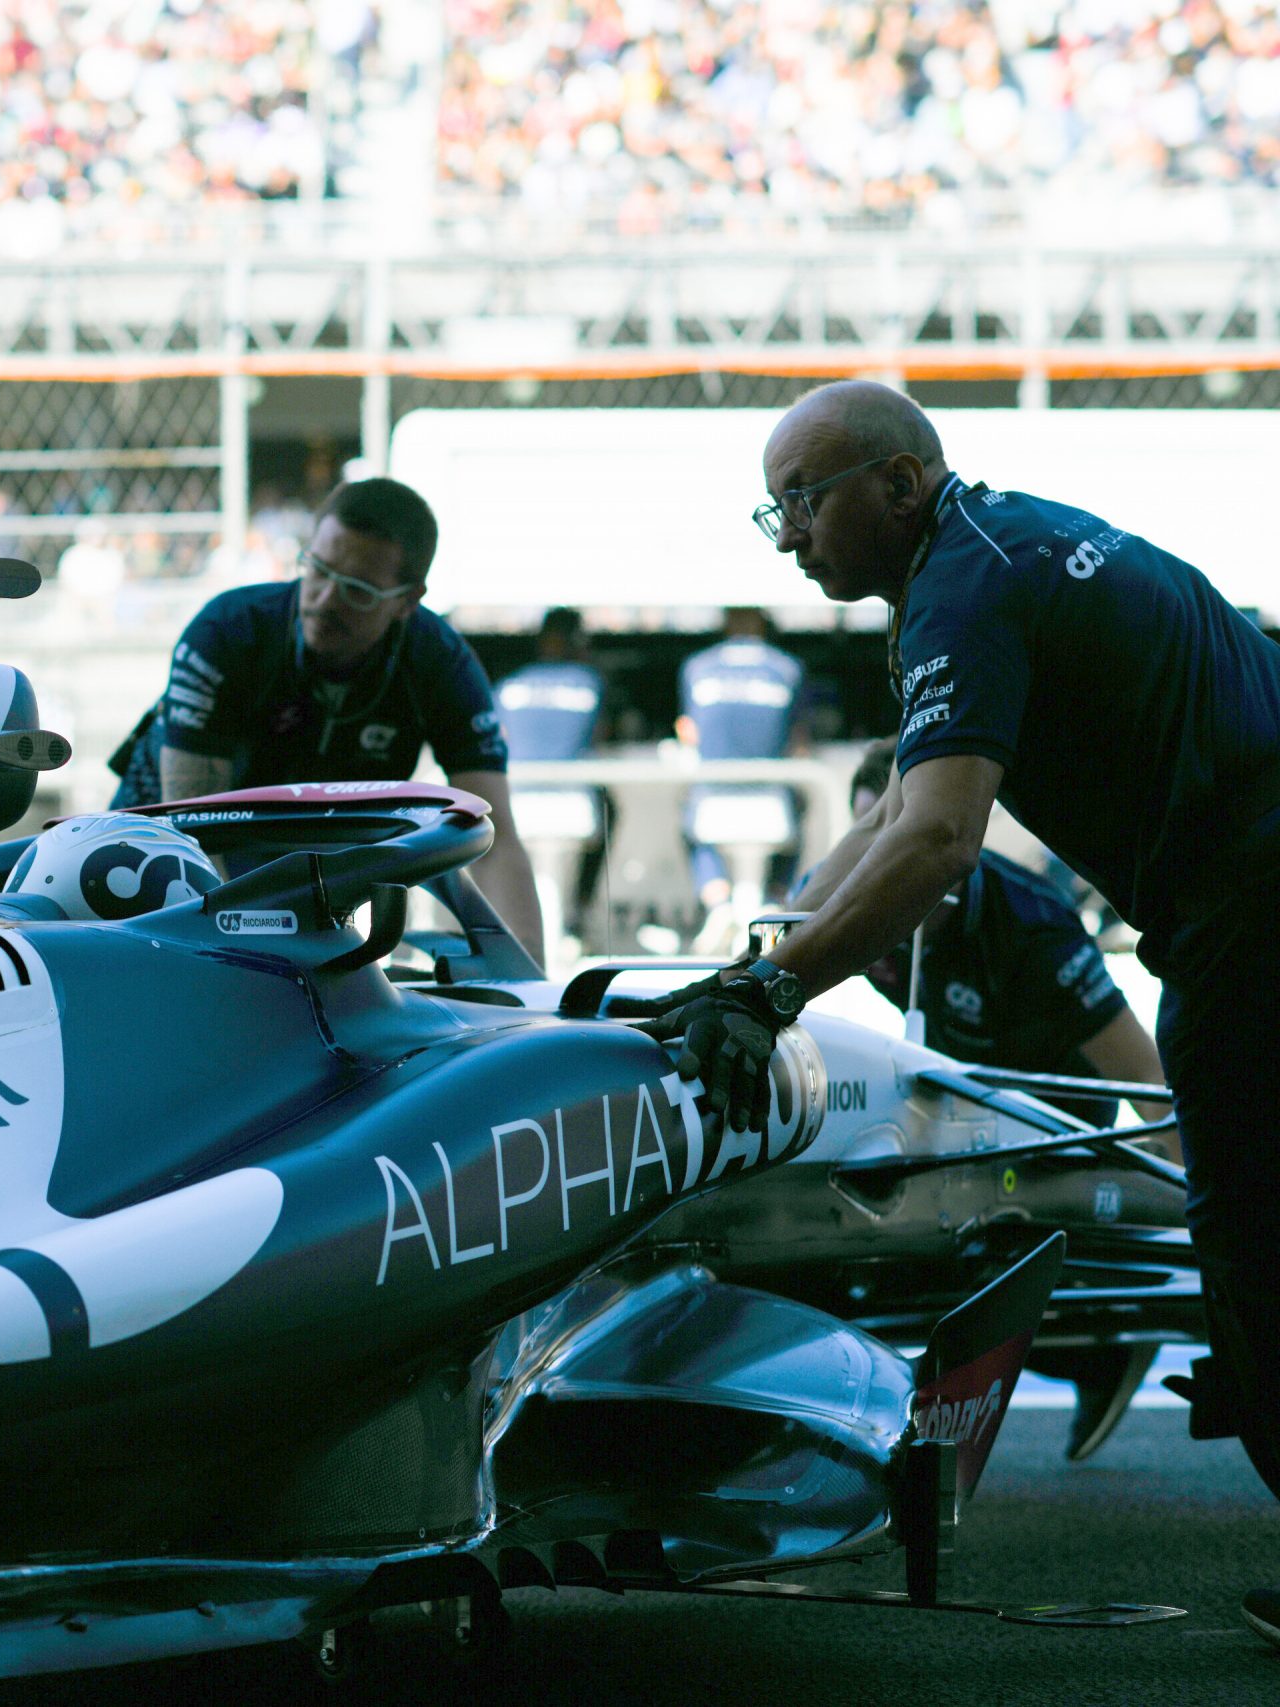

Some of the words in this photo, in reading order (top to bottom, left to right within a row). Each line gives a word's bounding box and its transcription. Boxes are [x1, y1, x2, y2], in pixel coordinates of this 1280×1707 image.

[913, 655, 950, 682] BUZZ
[323, 781, 403, 795] ORLEN
[243, 918, 281, 928] RICCIARDO
